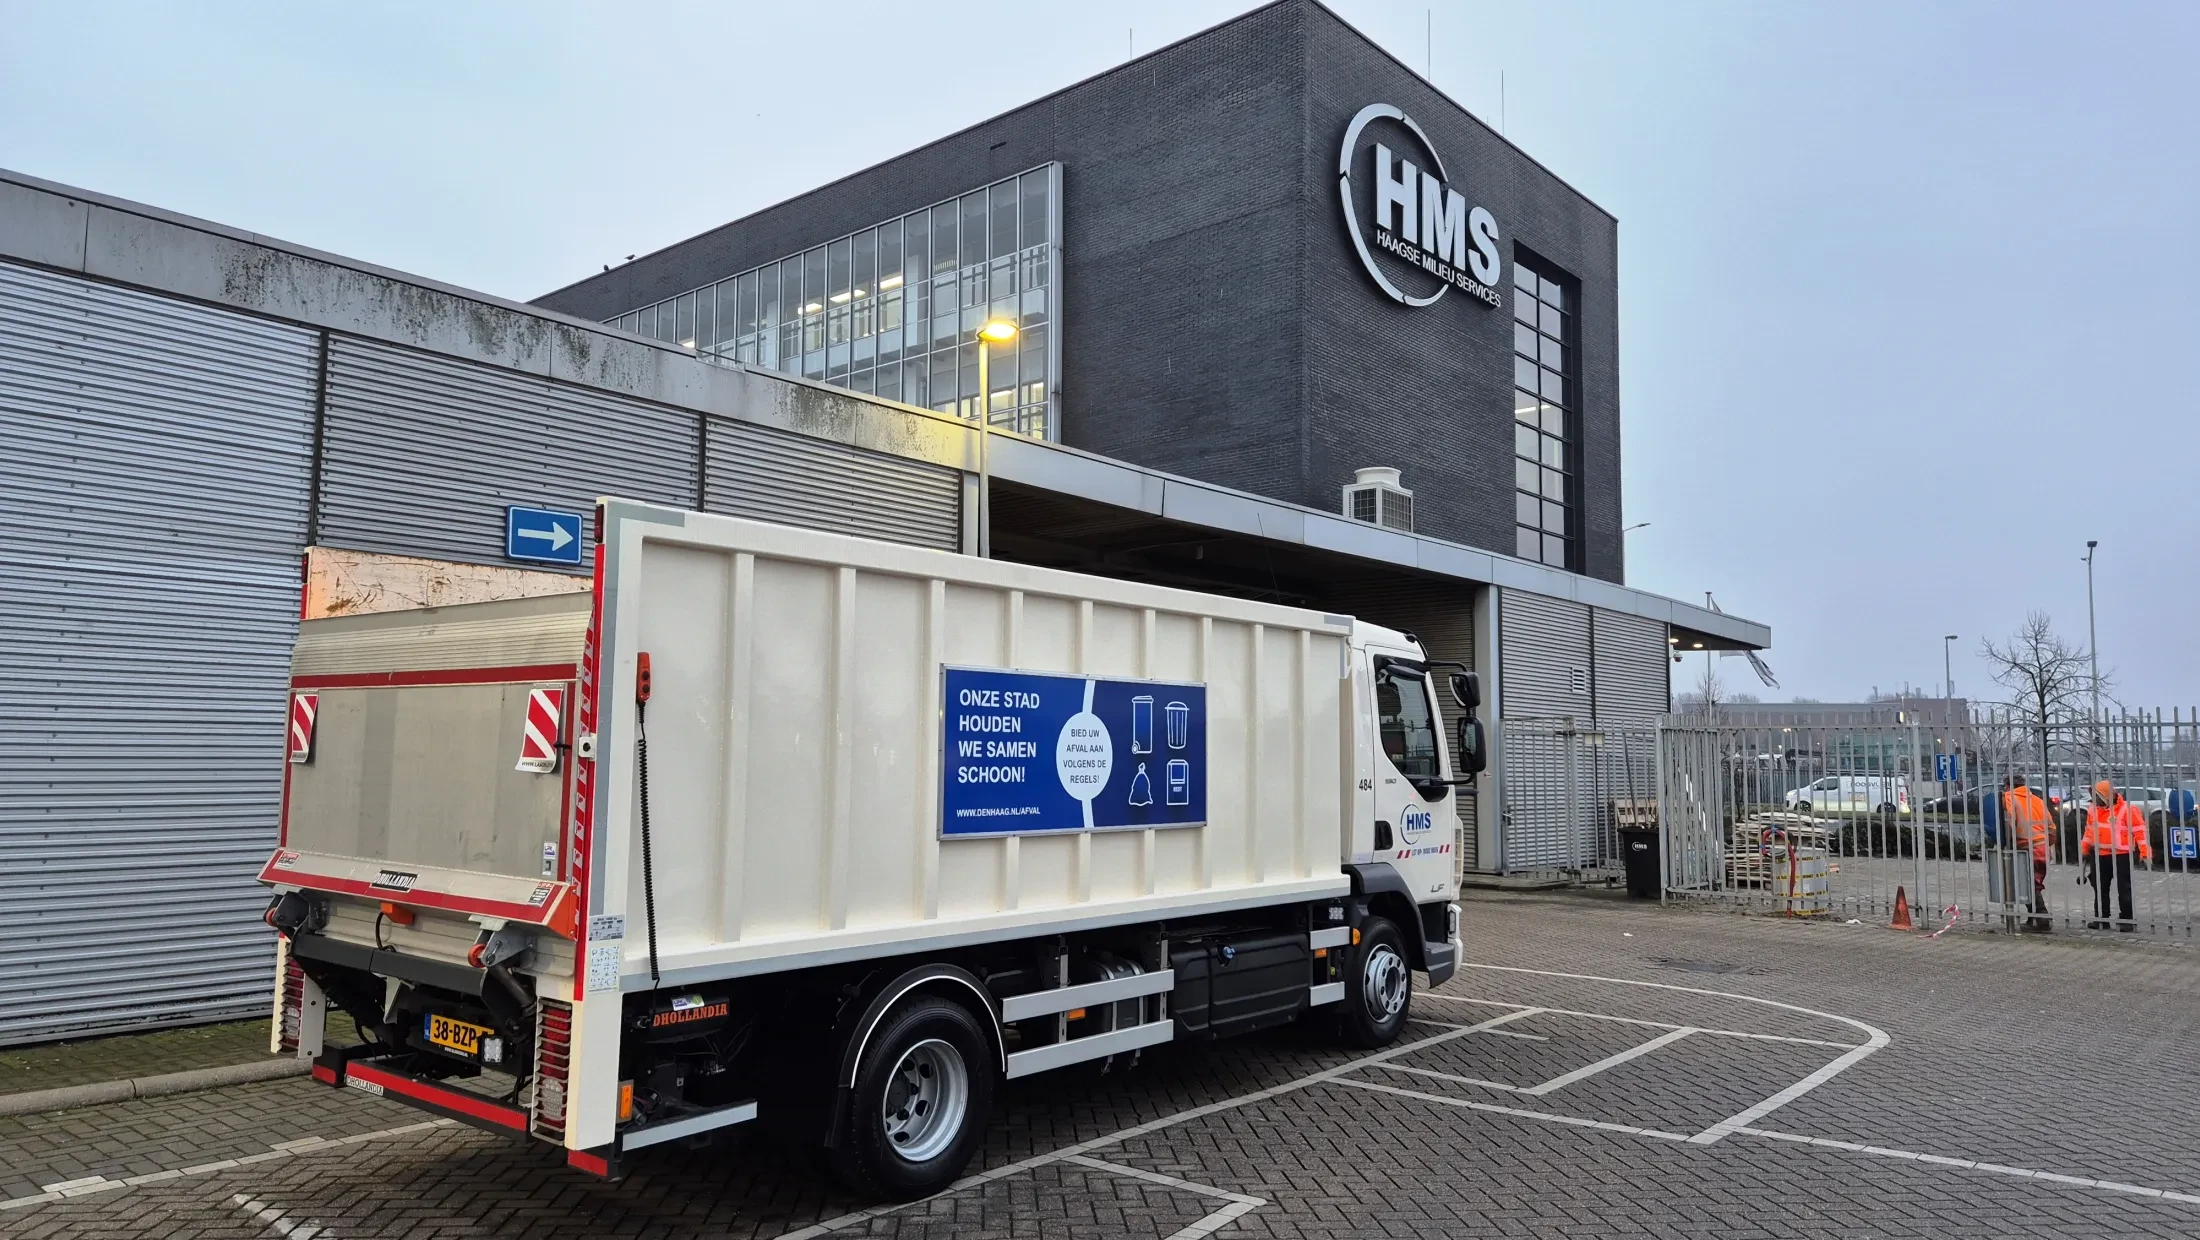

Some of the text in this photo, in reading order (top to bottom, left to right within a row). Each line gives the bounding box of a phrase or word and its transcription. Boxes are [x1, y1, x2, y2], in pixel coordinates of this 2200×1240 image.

[1375, 142, 1501, 287] HMS
[1377, 229, 1501, 308] HAAGSE MILIEU SERVICES
[959, 688, 1040, 709] ONZE STAD
[959, 714, 1021, 733] HOUDEN
[1071, 728, 1100, 738] BIED UW
[958, 740, 1037, 758] WE SAMEN
[1066, 744, 1104, 753] AFVAL AAN
[1063, 759, 1107, 768] VOLGENS DE
[957, 766, 1026, 784] SCHOON!
[1070, 774, 1100, 784] REGELS!
[1358, 778, 1373, 791] 484
[956, 806, 1041, 818] WWW.DENHAAG.NL/AFVAL
[1406, 812, 1431, 831] HMS
[1430, 883, 1445, 893] LF
[653, 1003, 728, 1027] DHOLLANDIA
